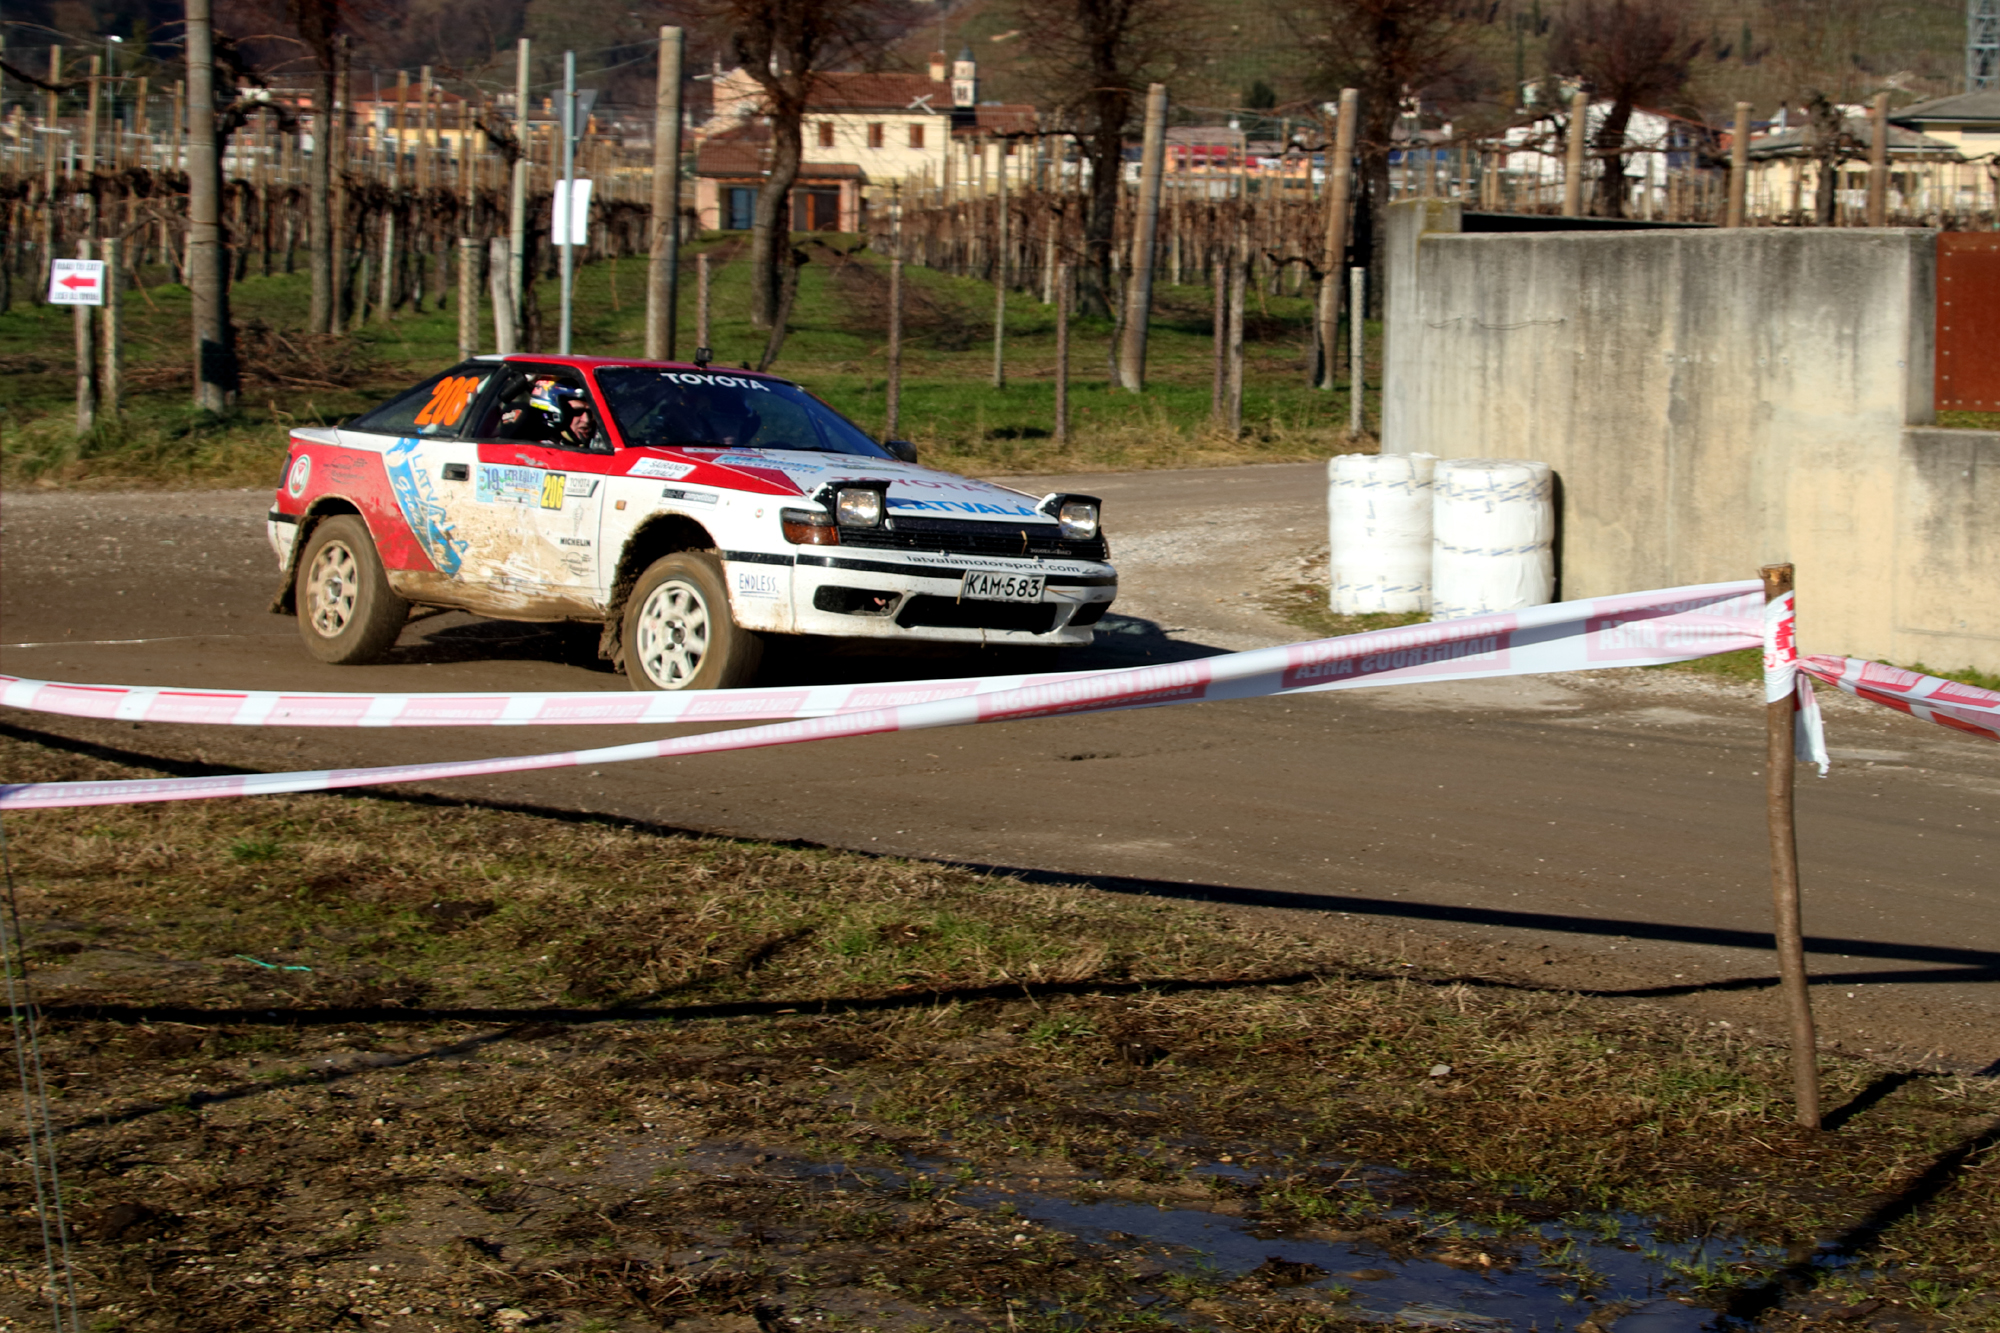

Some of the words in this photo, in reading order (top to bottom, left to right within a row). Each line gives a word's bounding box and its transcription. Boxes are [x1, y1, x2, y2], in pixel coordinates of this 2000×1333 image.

[660, 373, 771, 392] TOYOTA
[414, 376, 479, 426] 206
[486, 468, 500, 491] 19
[569, 477, 591, 488] TOYOTA
[540, 474, 566, 509] 206
[894, 498, 1046, 519] LATVALA
[560, 537, 591, 546] MICHELIN
[907, 555, 1081, 573] latvalamotorsport.com
[739, 573, 776, 591] ENDLESS
